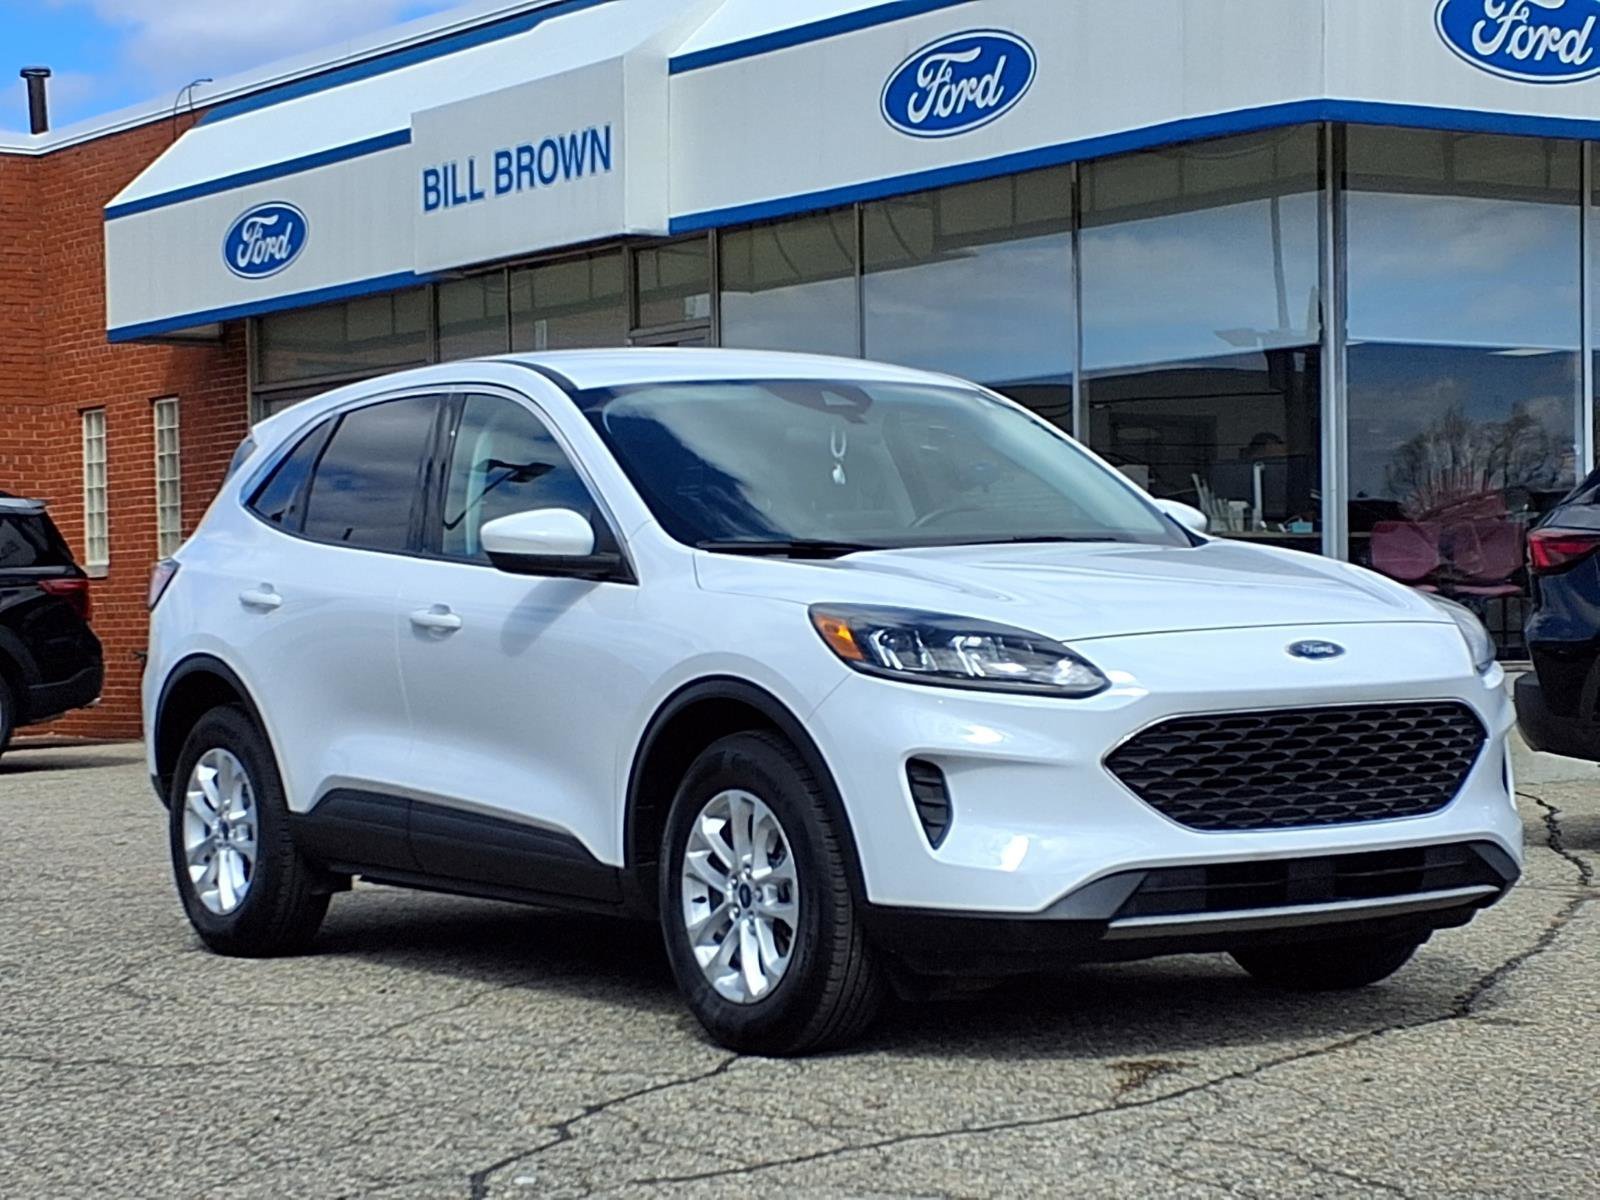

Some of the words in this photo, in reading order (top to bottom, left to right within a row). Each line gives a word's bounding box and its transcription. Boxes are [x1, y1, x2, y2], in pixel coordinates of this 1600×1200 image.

[1472, 0, 1597, 65] Ford
[907, 46, 1007, 124] Ford
[423, 157, 486, 212] BILL
[495, 124, 612, 195] BROWN
[237, 214, 293, 268] Ford
